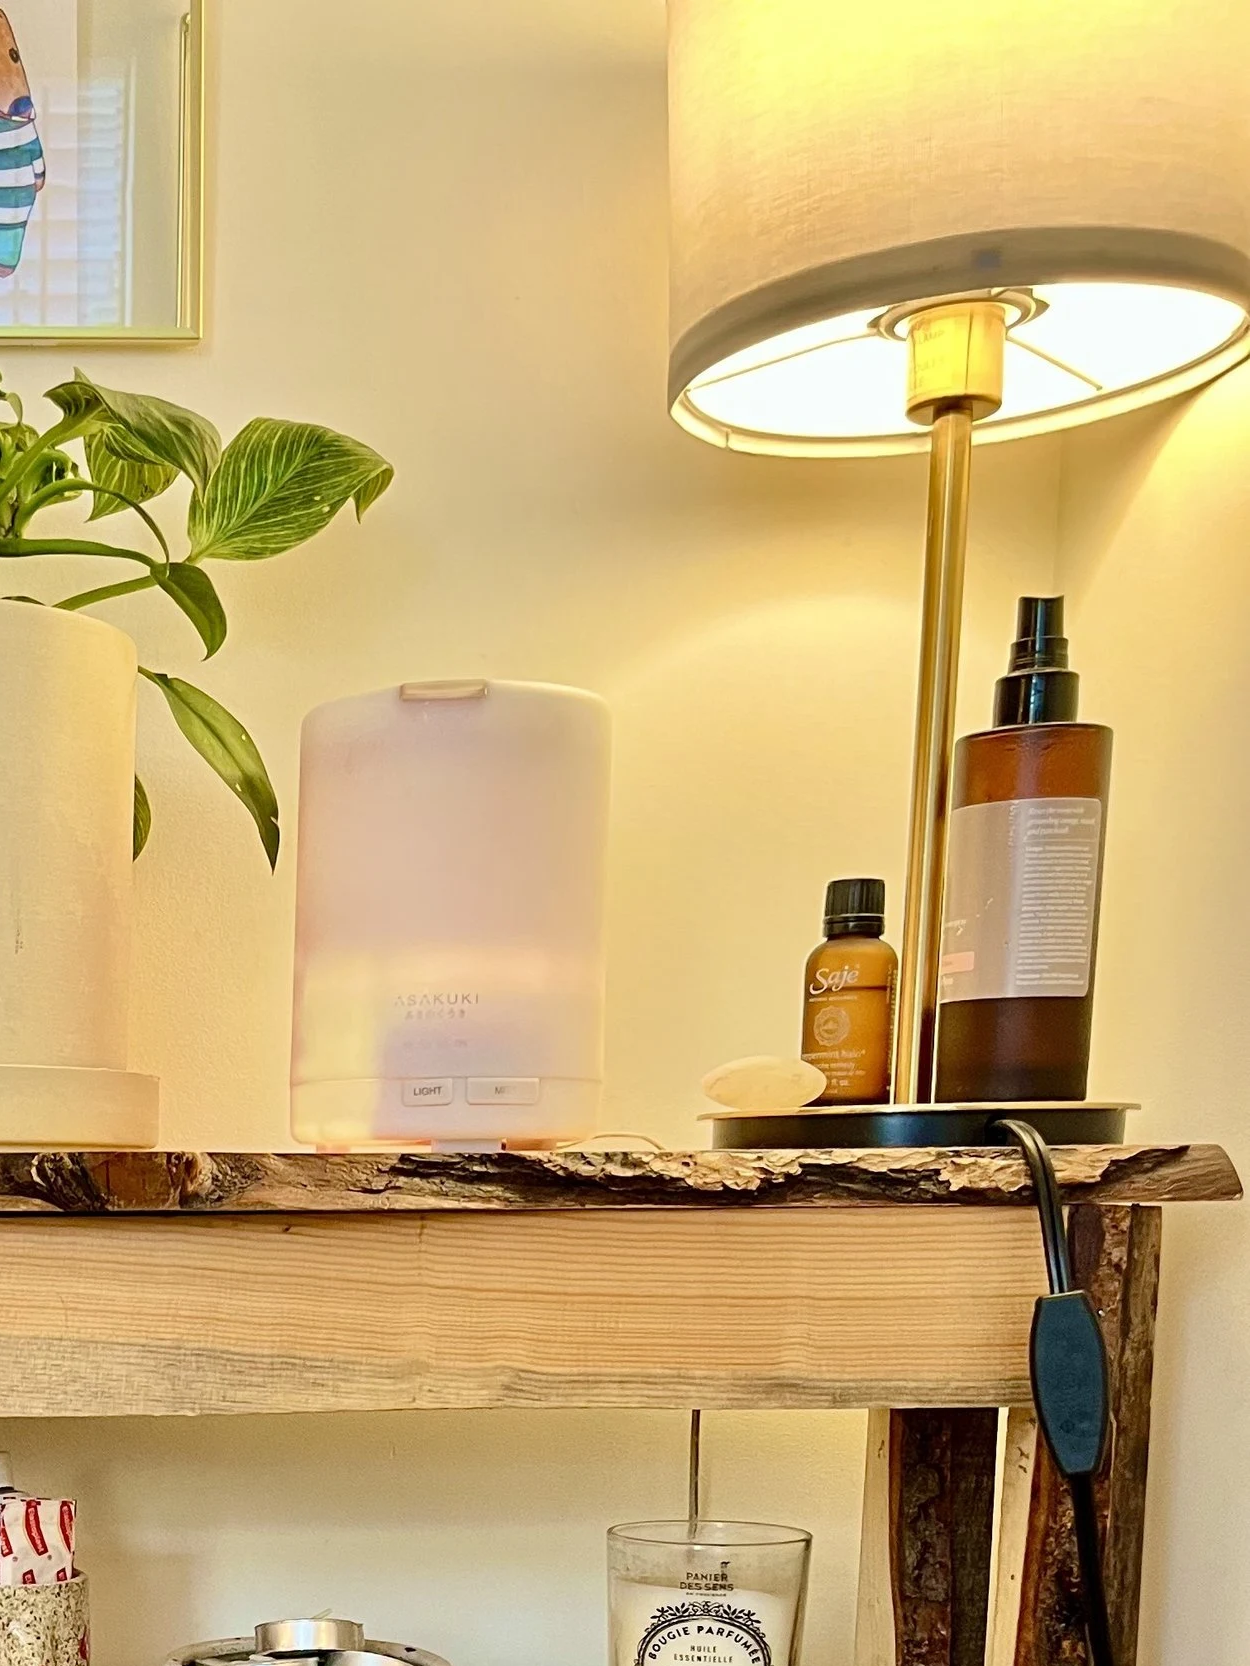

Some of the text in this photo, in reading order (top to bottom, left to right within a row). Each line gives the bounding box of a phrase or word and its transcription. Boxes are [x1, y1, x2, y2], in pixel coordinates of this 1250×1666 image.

[810, 965, 859, 995] Saje
[393, 992, 479, 1007] ASAKUKI
[413, 1086, 442, 1097] LIGHT
[686, 1572, 728, 1582] PANIER
[680, 1582, 734, 1592] DES SENS
[648, 1625, 761, 1665] BOUGIE PARFUMÉE
[690, 1645, 717, 1653] HUILE
[674, 1654, 733, 1664] ESSENTIELLE
